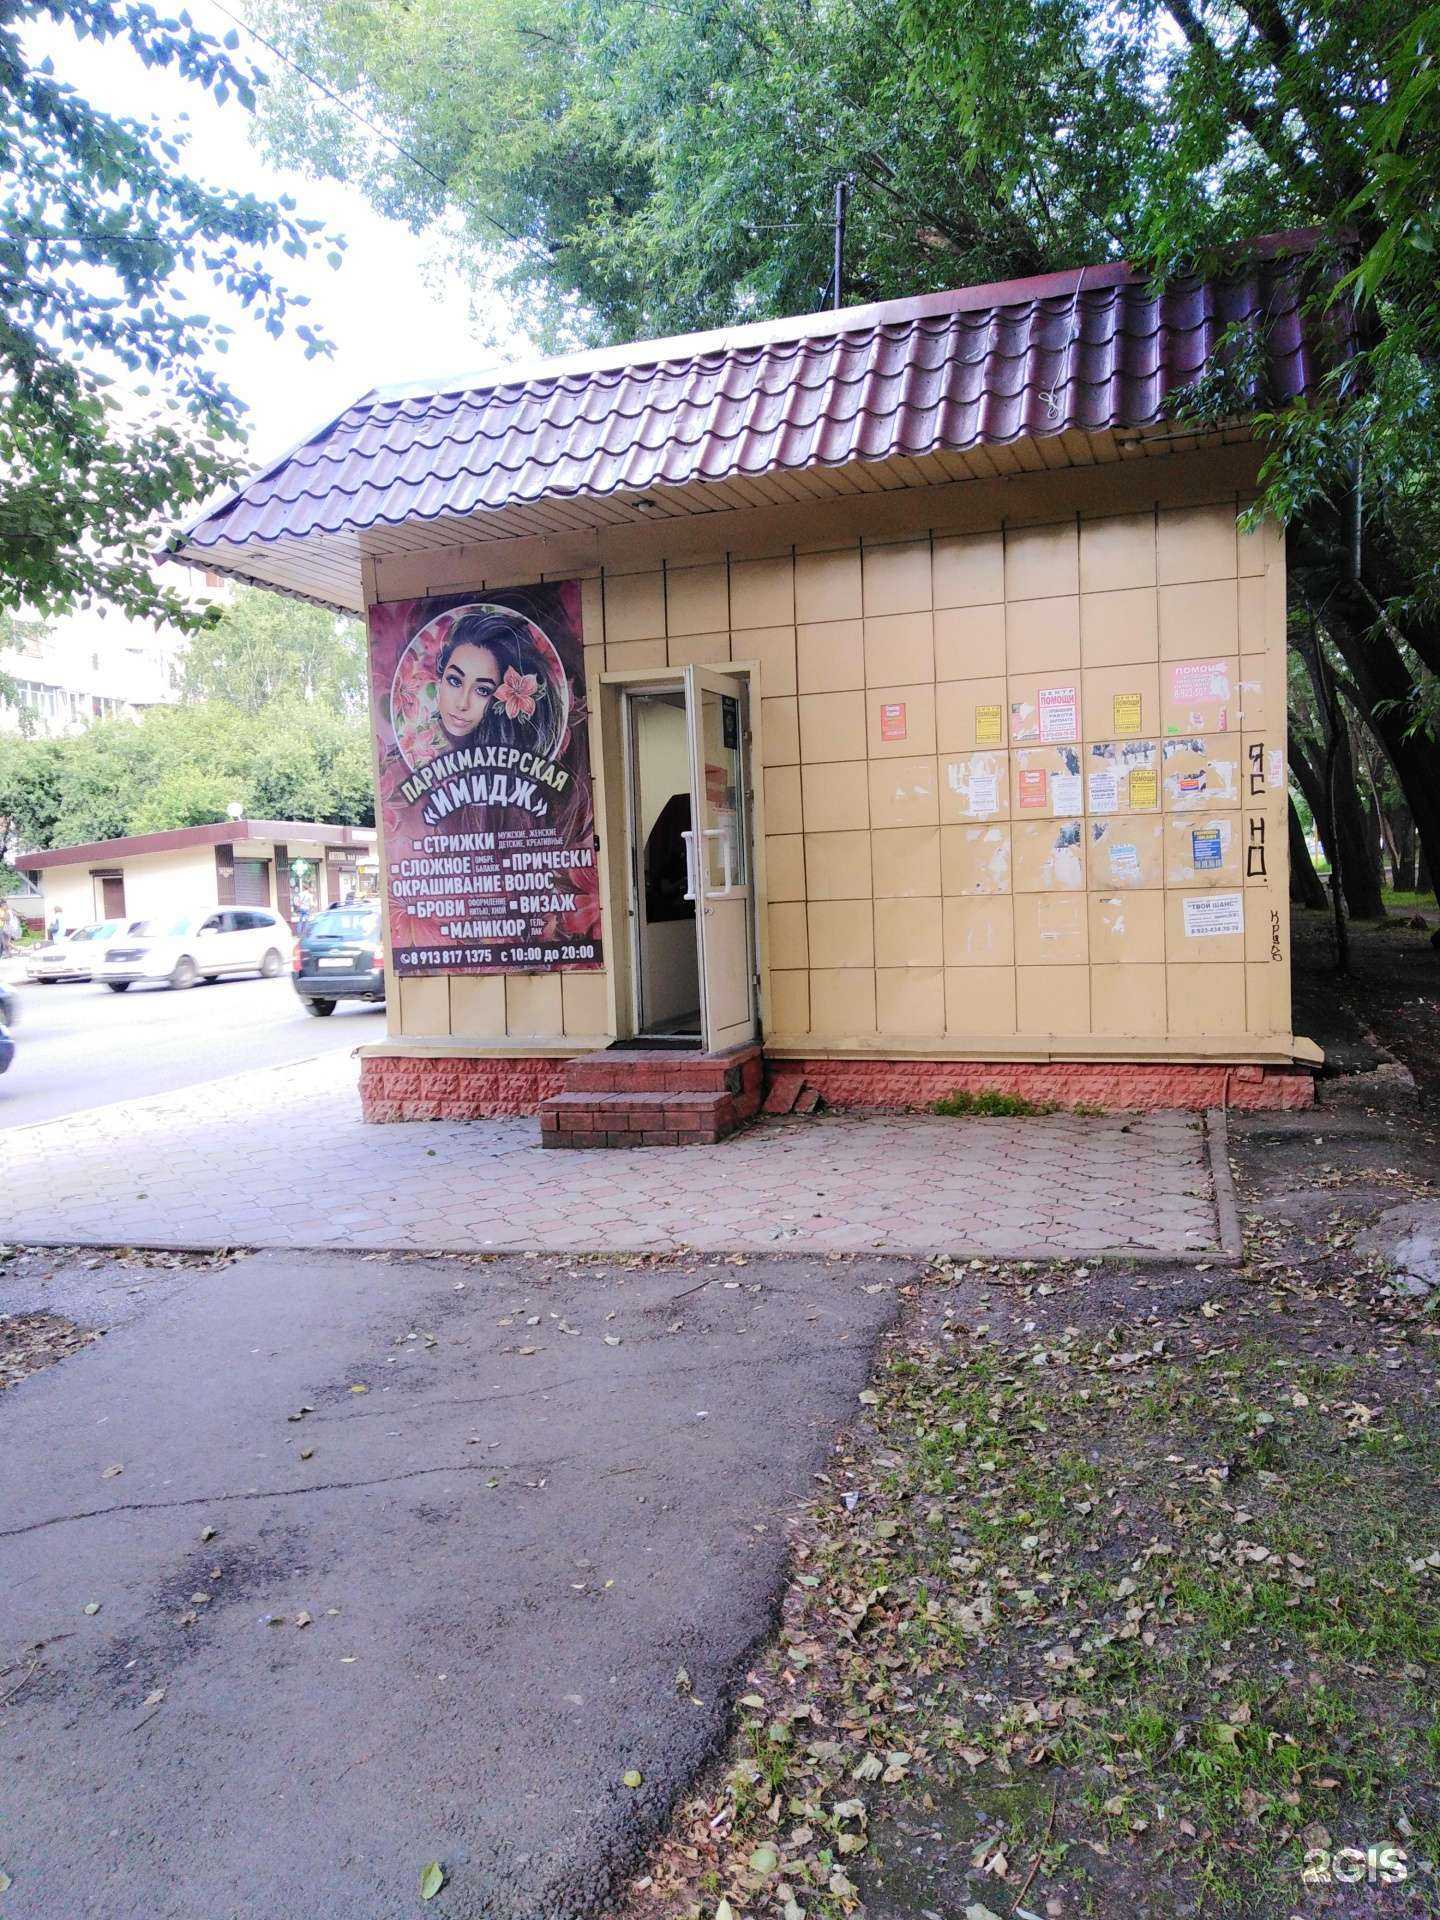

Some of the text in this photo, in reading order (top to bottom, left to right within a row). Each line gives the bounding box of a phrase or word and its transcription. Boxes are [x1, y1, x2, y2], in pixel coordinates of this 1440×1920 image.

[1040, 696, 1075, 705] ПОМОЩИ
[401, 746, 570, 803] ПАРИКМАХЕРСКАЯ
[423, 774, 548, 825] «ИМИДЖ»
[424, 832, 495, 854] СТРИЖКИ
[527, 837, 564, 847] КРЕАТИВНЫЕ
[530, 828, 557, 838] ЖЕНСКИЕ
[400, 857, 471, 877] СЛОЖНОЕ
[474, 855, 495, 864] ОМБРЕ
[512, 849, 592, 871] ПРИЧЕСКИ
[392, 872, 554, 897] ОКРАШИВАНИЕ ВОЛОС
[416, 899, 466, 918] БРОВИ
[520, 894, 576, 914] ВИЗАЖ
[449, 919, 526, 939] МАНИКЮР
[530, 927, 543, 936] ЛАК
[411, 951, 418, 965] 8
[419, 951, 441, 965] 913
[442, 950, 462, 964] 817
[465, 949, 492, 963] 1375
[510, 947, 541, 961] 10:00
[543, 948, 559, 963] до
[561, 945, 594, 960] 20:00
